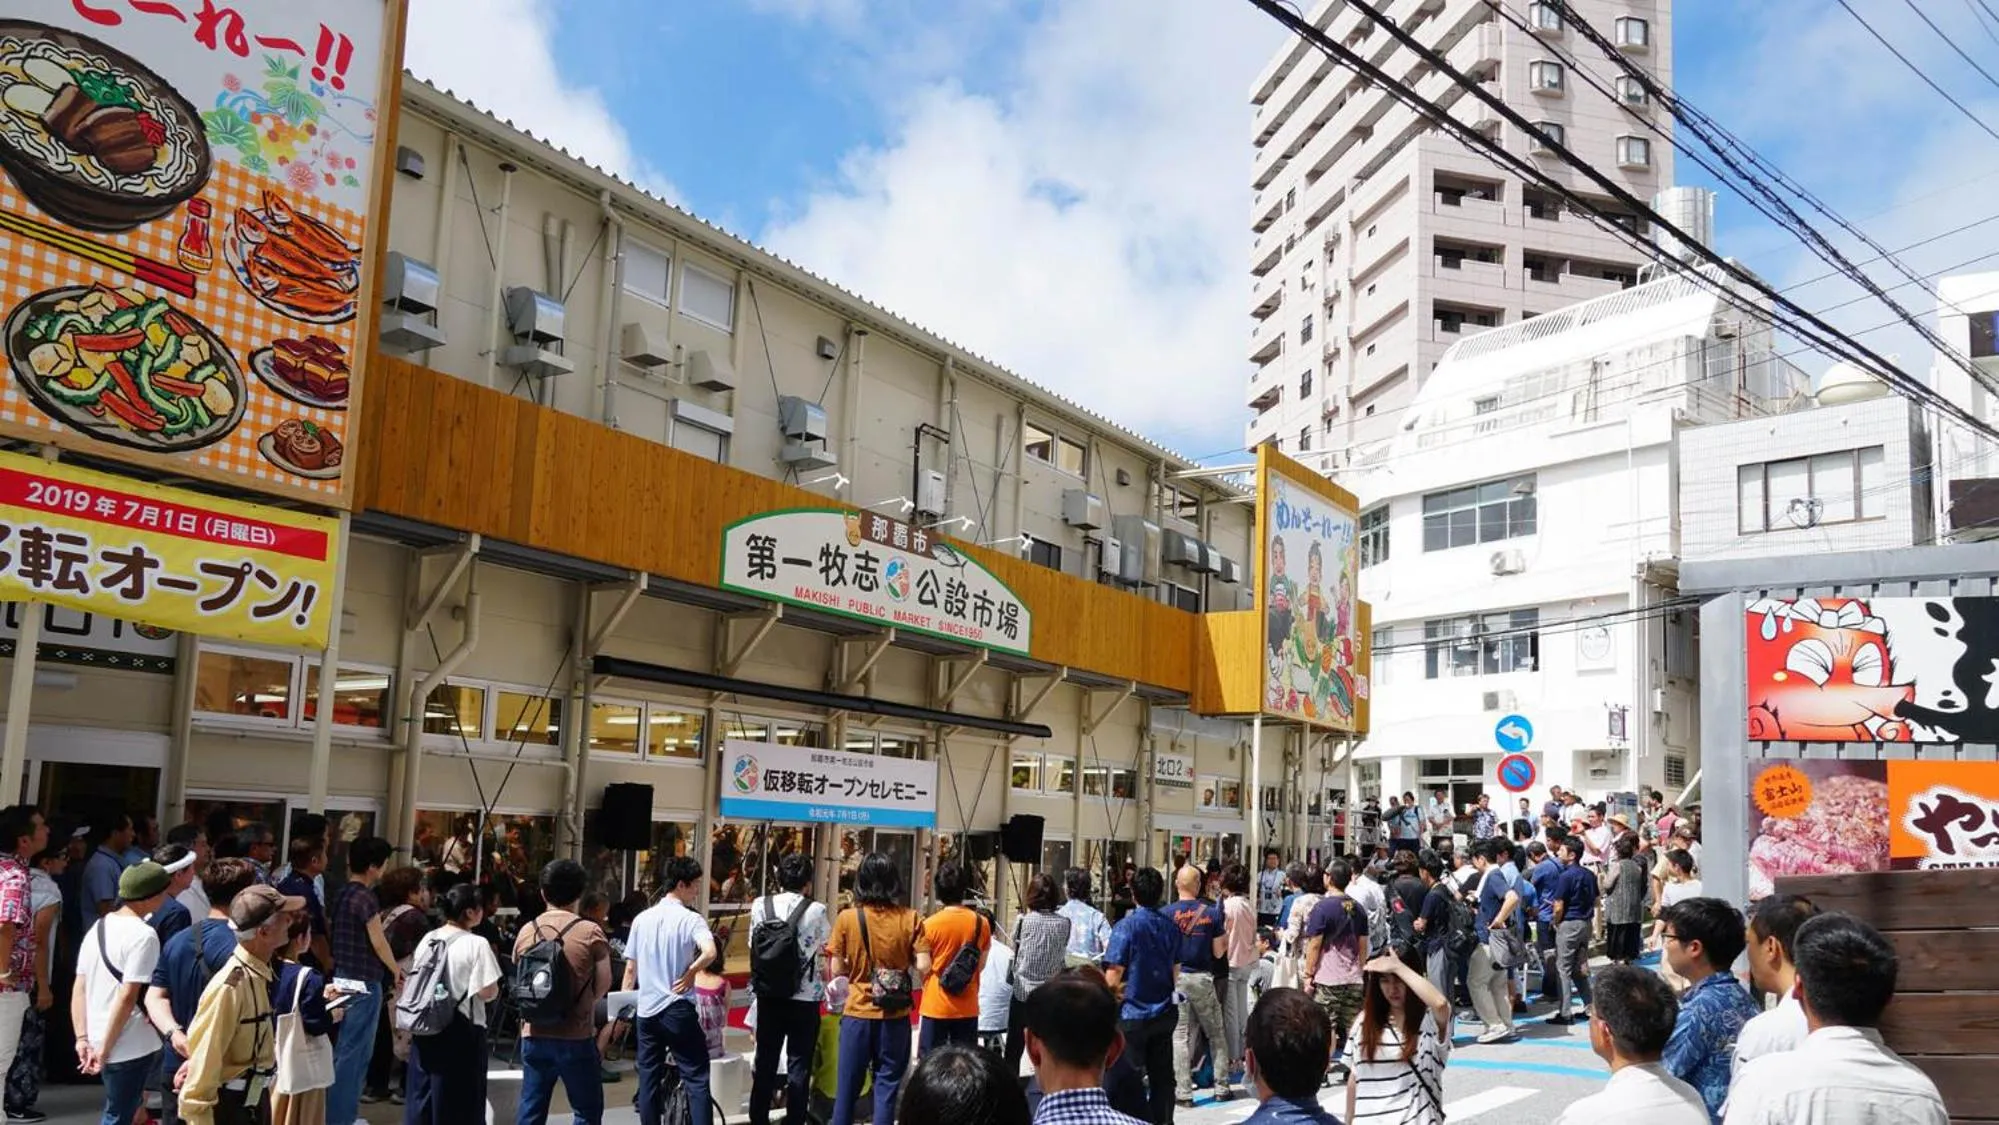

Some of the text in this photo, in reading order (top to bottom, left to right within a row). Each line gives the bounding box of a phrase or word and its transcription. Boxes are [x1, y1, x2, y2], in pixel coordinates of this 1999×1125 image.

[872, 515, 928, 552] 那覇市
[0, 524, 316, 626] 転オープン!
[794, 586, 840, 608] MAKISHI
[848, 599, 886, 618] PUBLIC
[893, 611, 932, 628] MARKET
[763, 769, 928, 801] 仮移転オープンセレモニー
[1157, 758, 1182, 776] 北口2
